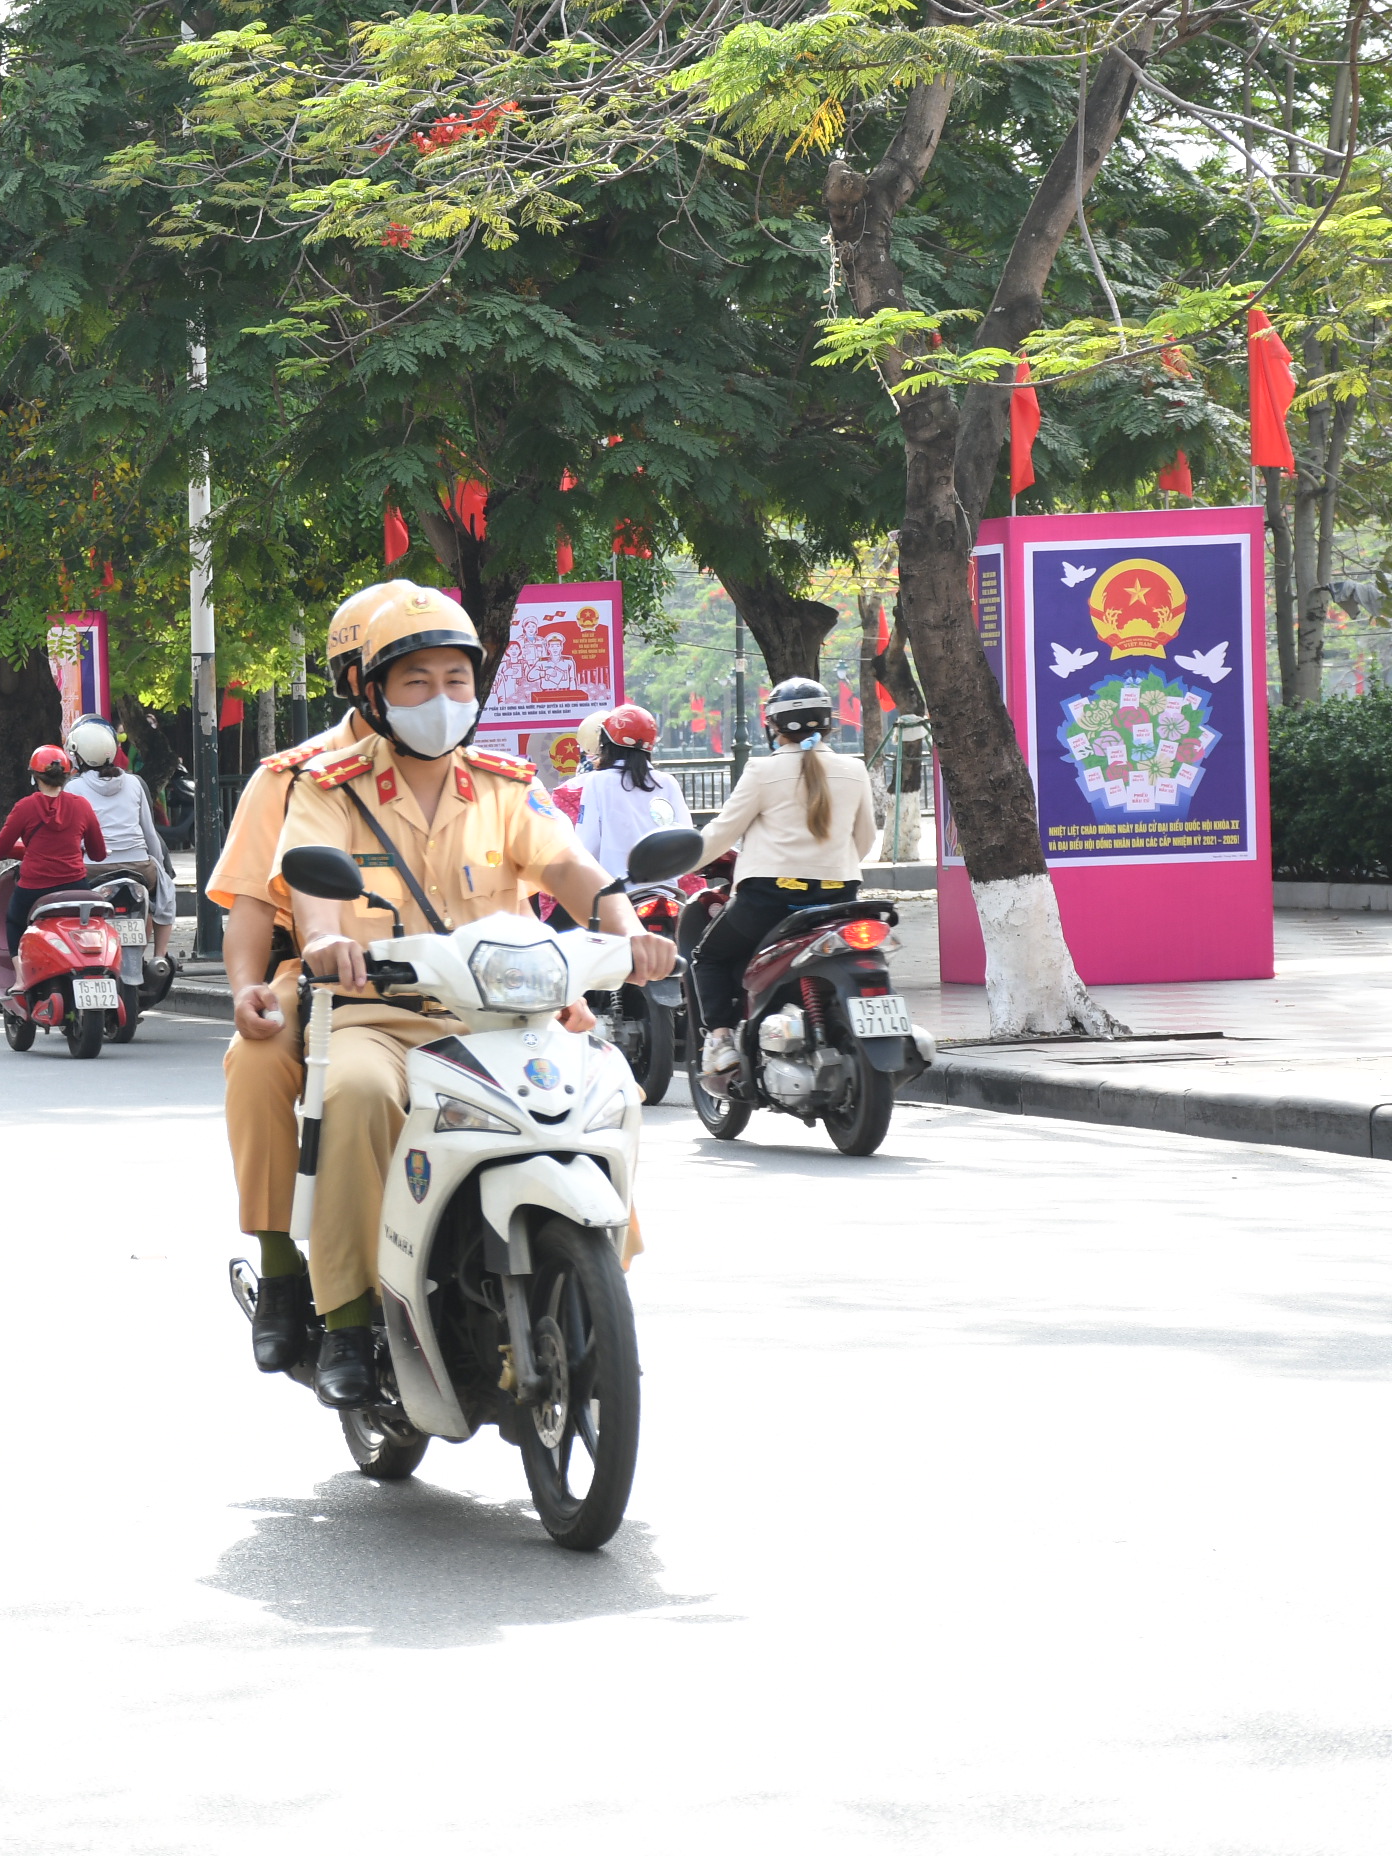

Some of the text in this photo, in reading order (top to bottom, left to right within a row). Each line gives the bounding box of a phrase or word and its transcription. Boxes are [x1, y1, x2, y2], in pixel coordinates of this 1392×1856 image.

[328, 624, 361, 649] SGT
[1049, 825, 1066, 838] NHIỆT
[1068, 824, 1079, 837] LIỆT
[1081, 824, 1097, 835] CHÀO
[1118, 822, 1134, 834] NGÀY
[1169, 818, 1184, 832] BIỂU
[1184, 818, 1200, 832] QUỐC
[1202, 819, 1212, 832] HỘI
[1049, 840, 1057, 851] VÀ
[1084, 838, 1095, 851] HỘI
[1114, 837, 1130, 848] NHÂN
[1145, 836, 1158, 847] CÁC
[1172, 835, 1192, 848] NHIỆM
[1203, 835, 1217, 845] 2021
[78, 994, 116, 1007] 191.22
[858, 999, 898, 1015] 15-H1
[856, 1016, 908, 1034] 371.40
[384, 1224, 414, 1258] YAMAHA
